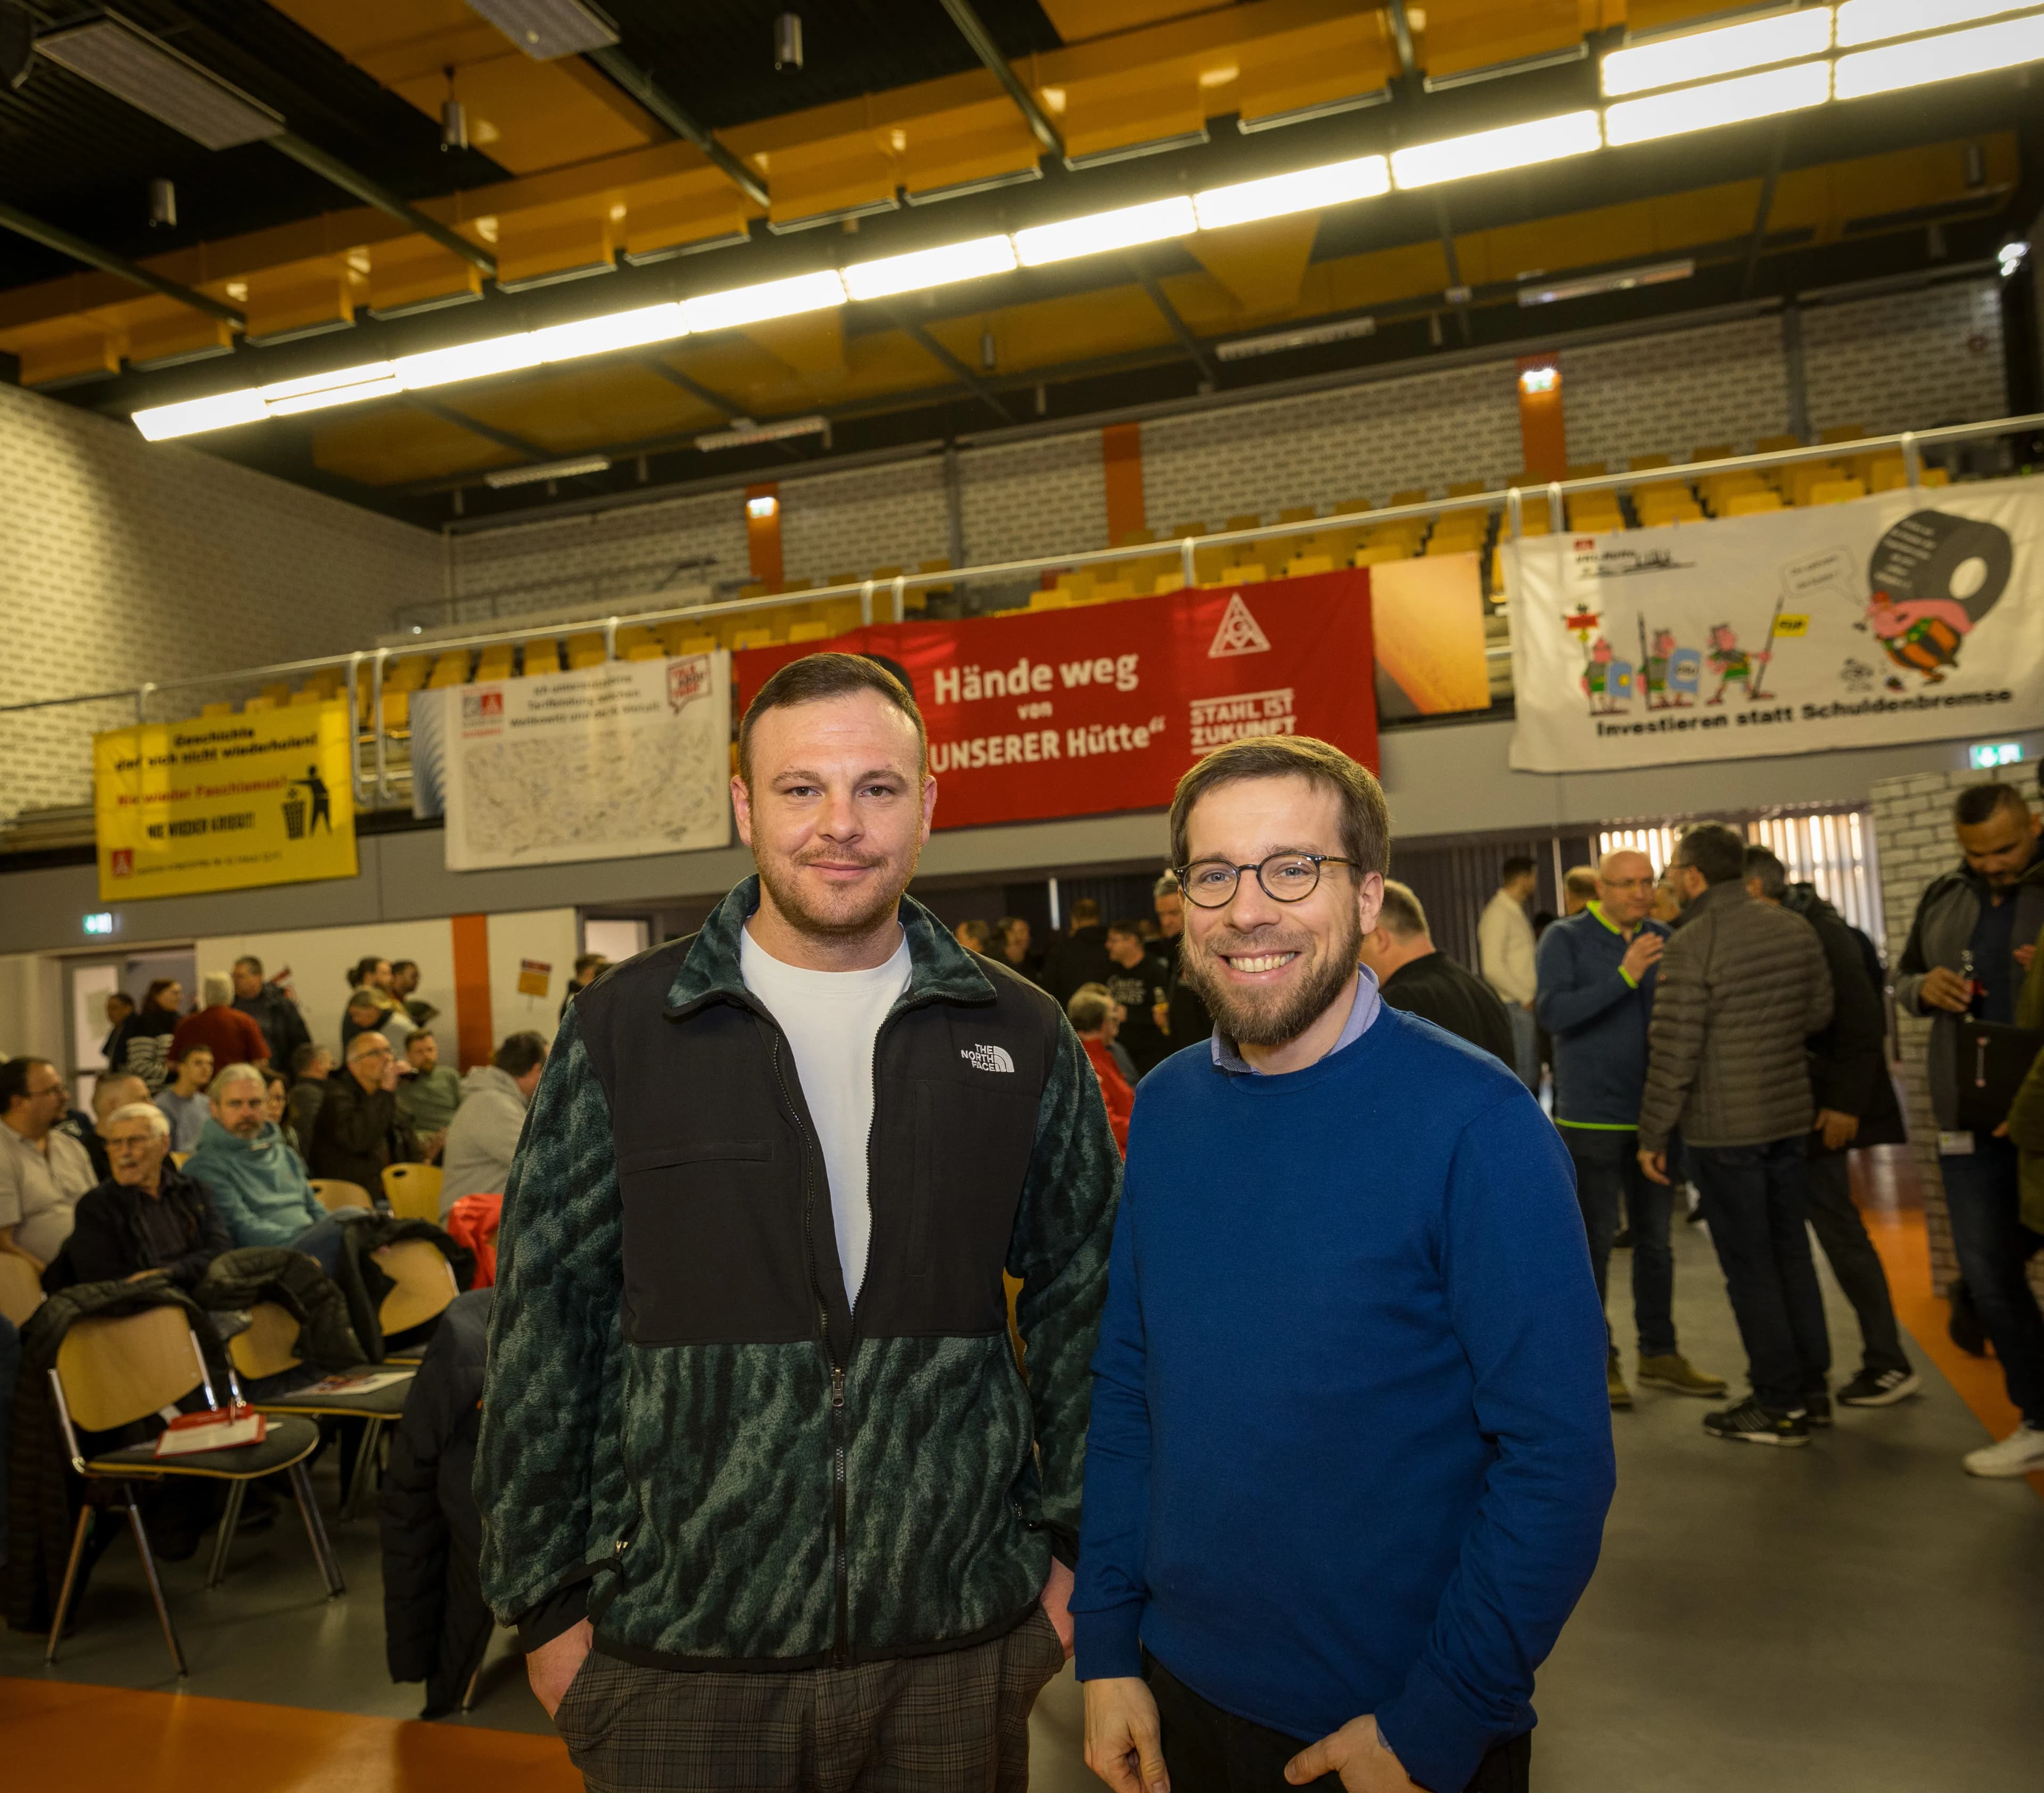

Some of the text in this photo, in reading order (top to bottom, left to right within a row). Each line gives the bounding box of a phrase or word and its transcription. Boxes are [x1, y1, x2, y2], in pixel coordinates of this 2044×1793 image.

[934, 652, 1140, 705] Hände weg
[1017, 701, 1053, 721] von
[1190, 695, 1293, 725] STAHL IST
[1597, 689, 2012, 738] Investieren statt Schuldenbremse
[1190, 715, 1297, 746] ZUKUNFT
[930, 730, 1061, 773] UNSERER
[961, 1050, 994, 1063] NORTH
[975, 1043, 994, 1054] THE
[971, 1060, 996, 1072] FACE
